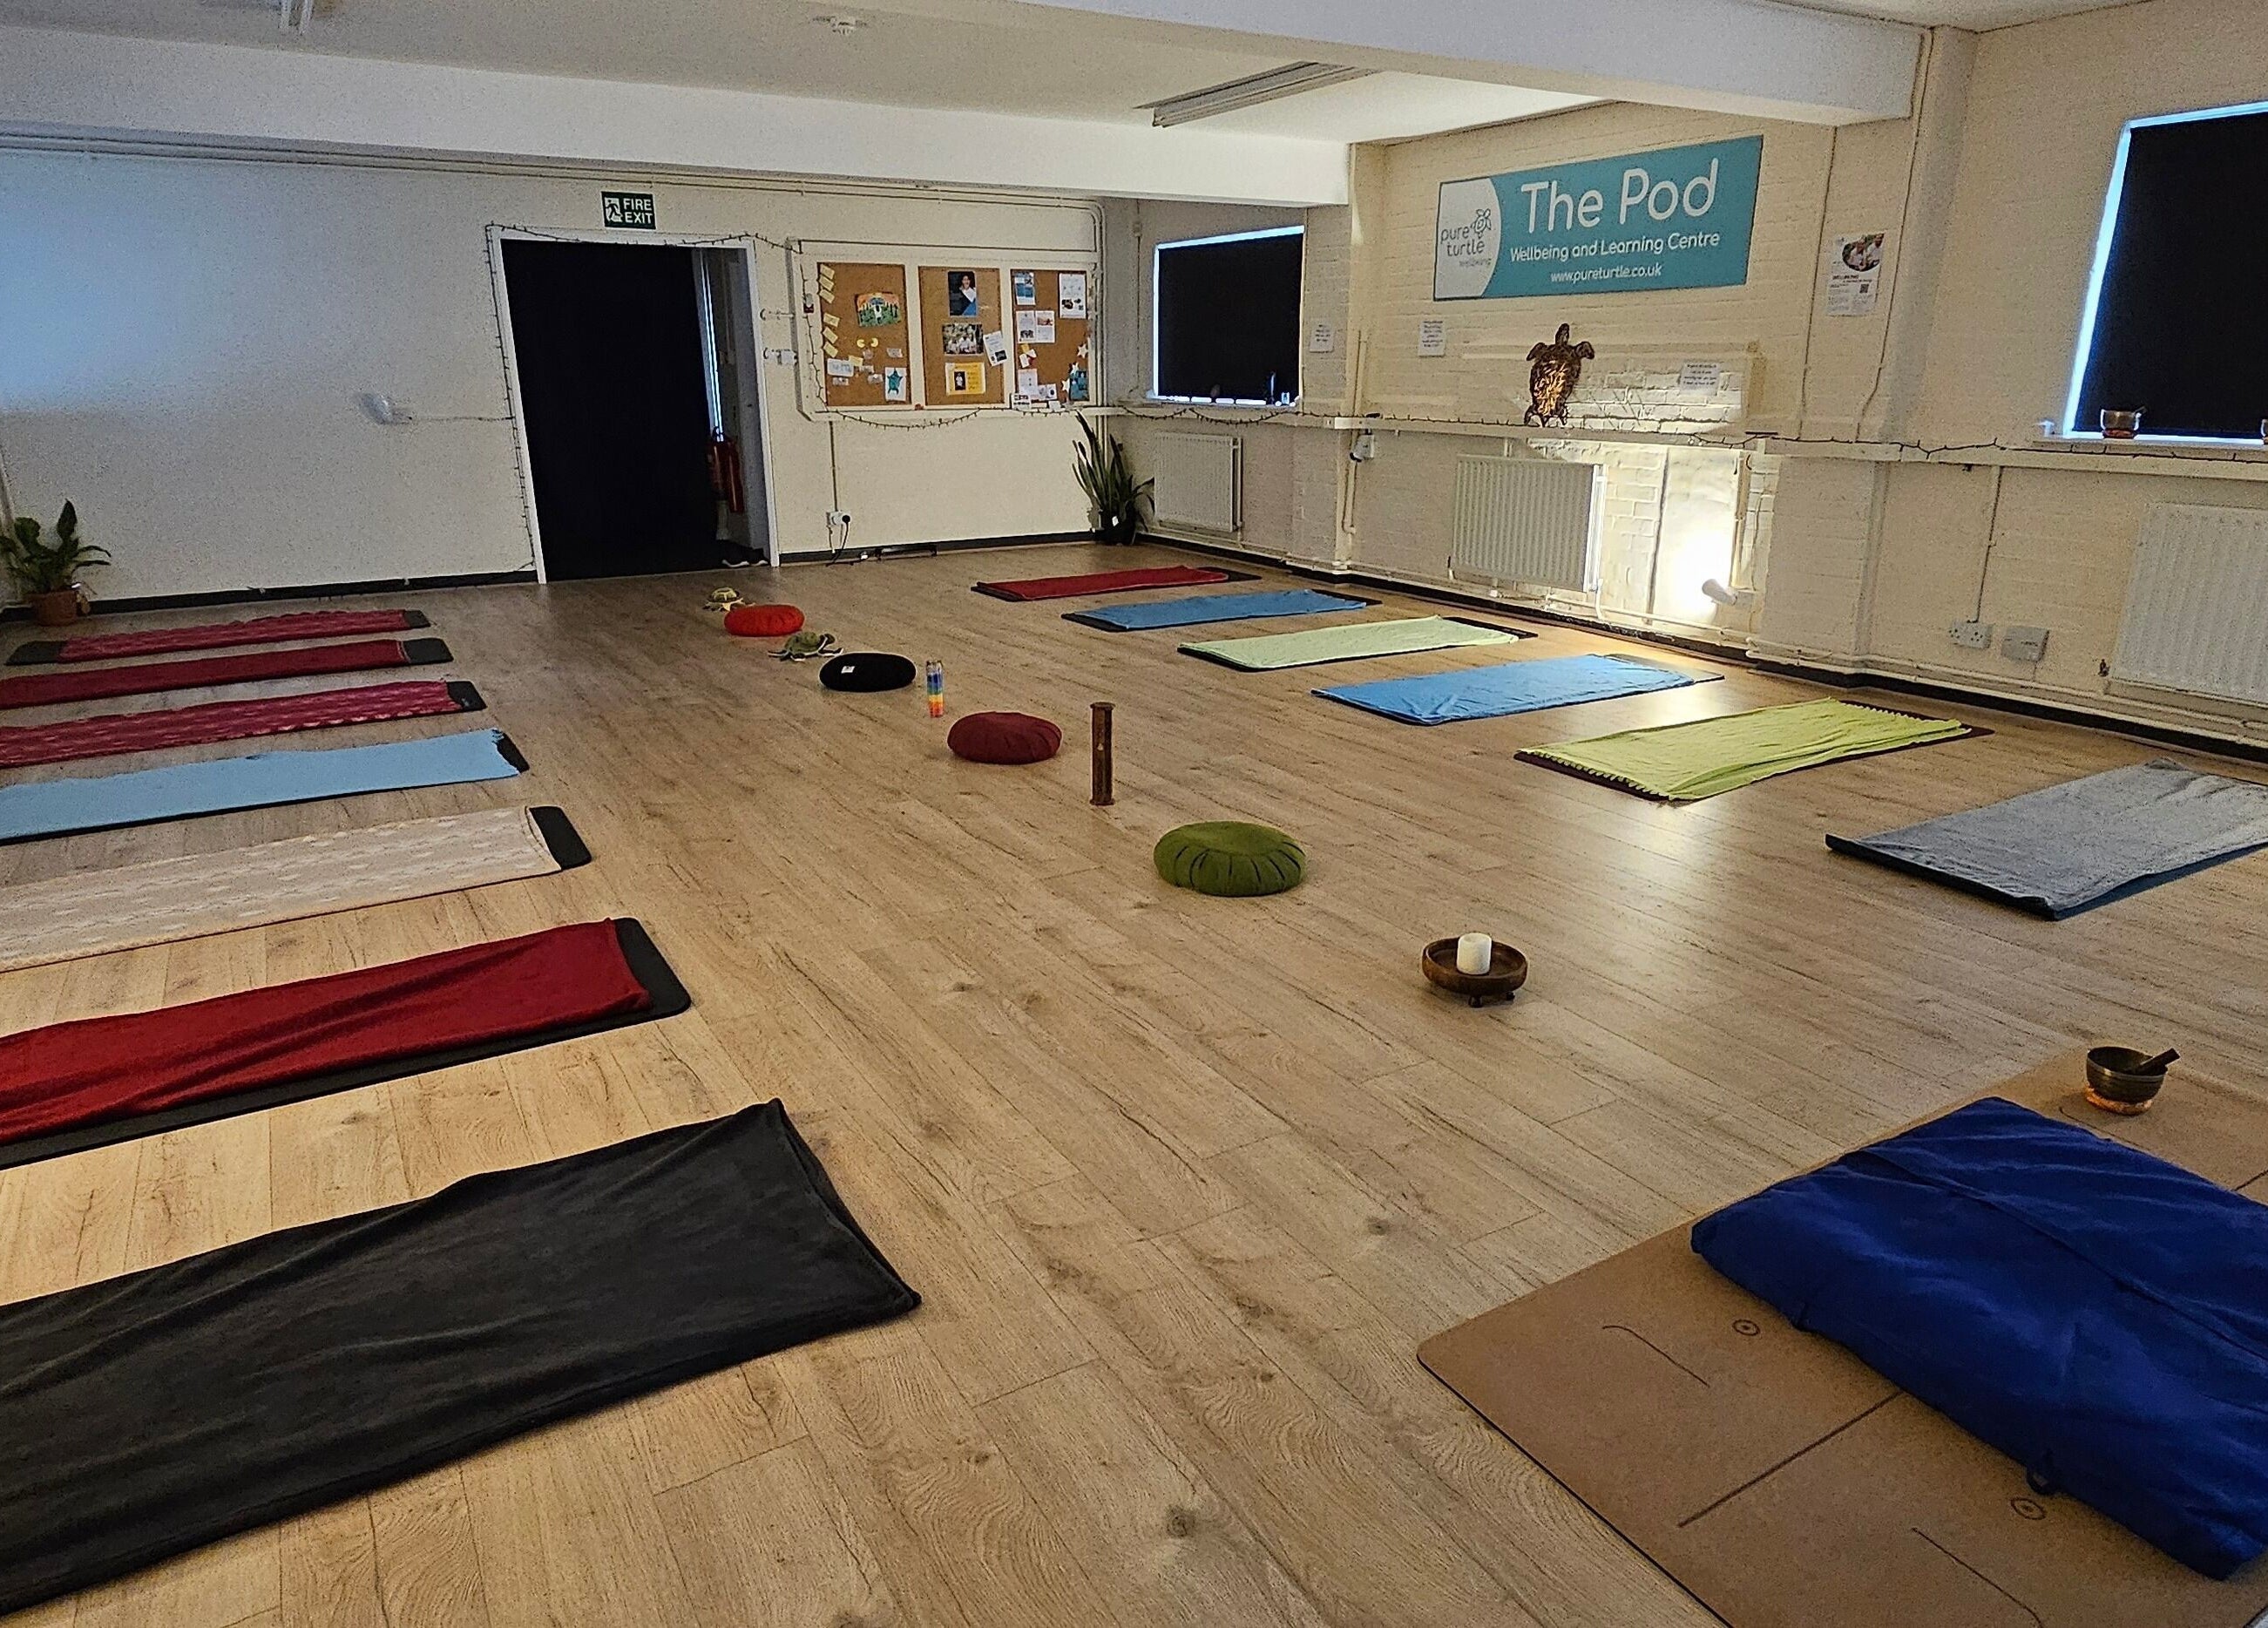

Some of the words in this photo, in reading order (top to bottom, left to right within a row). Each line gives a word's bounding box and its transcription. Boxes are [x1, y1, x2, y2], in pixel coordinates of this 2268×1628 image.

[623, 198, 653, 211] FIRE
[1520, 180, 1603, 234] The
[1618, 158, 1719, 225] Pod
[625, 212, 653, 224] EXIT
[1440, 227, 1470, 244] pure
[1446, 239, 1485, 257] turtle
[1510, 245, 1569, 262] Wellbeing
[1572, 240, 1598, 257] and
[1601, 235, 1664, 254] Learning
[1668, 231, 1720, 249] Centre
[1551, 262, 1662, 284] www.pureturtle.co.uk
